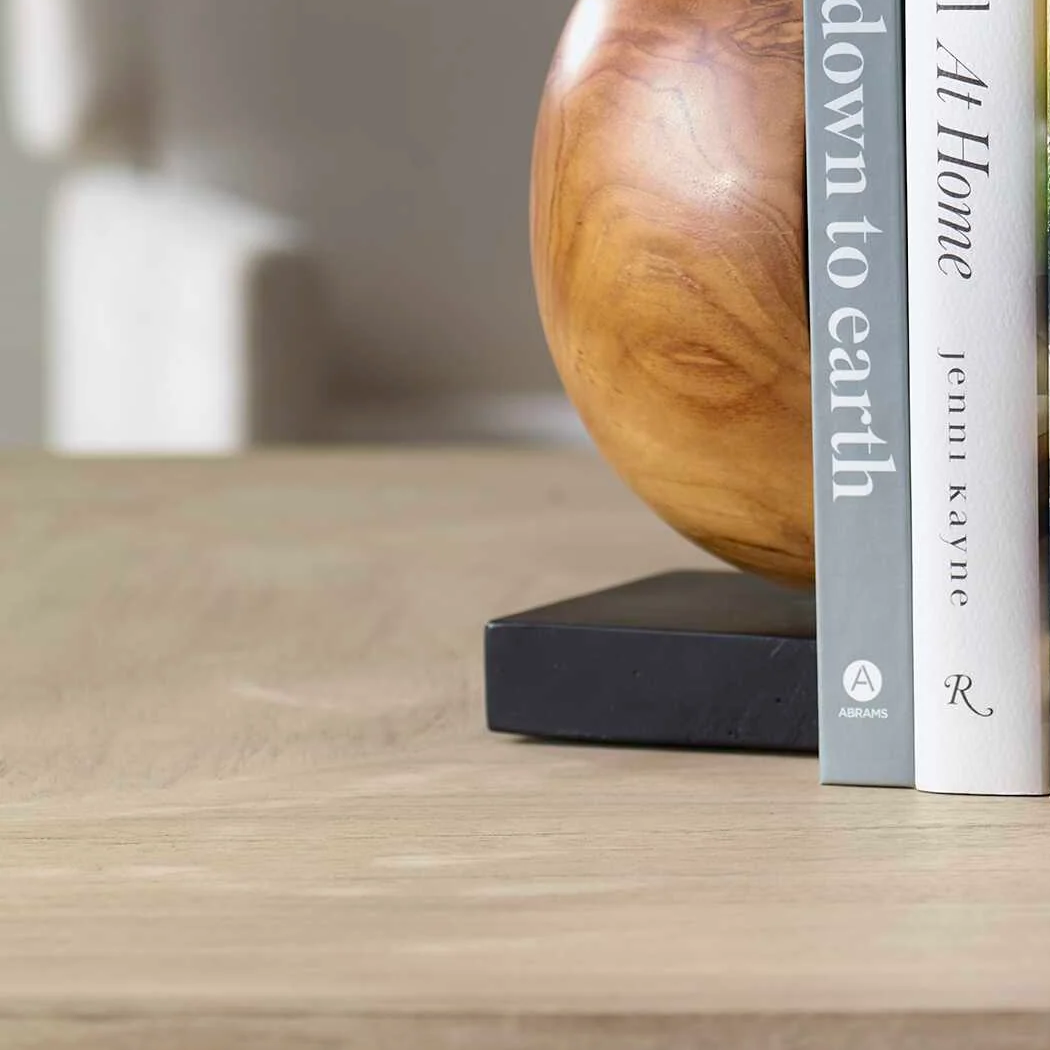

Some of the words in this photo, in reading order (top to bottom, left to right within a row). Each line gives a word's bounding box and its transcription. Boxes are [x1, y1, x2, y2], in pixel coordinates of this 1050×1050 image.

[936, 38, 989, 110] At
[936, 121, 990, 280] Home
[825, 215, 883, 289] to
[827, 306, 897, 502] earth
[838, 707, 889, 719] ABRAMS
[944, 673, 994, 718] R
